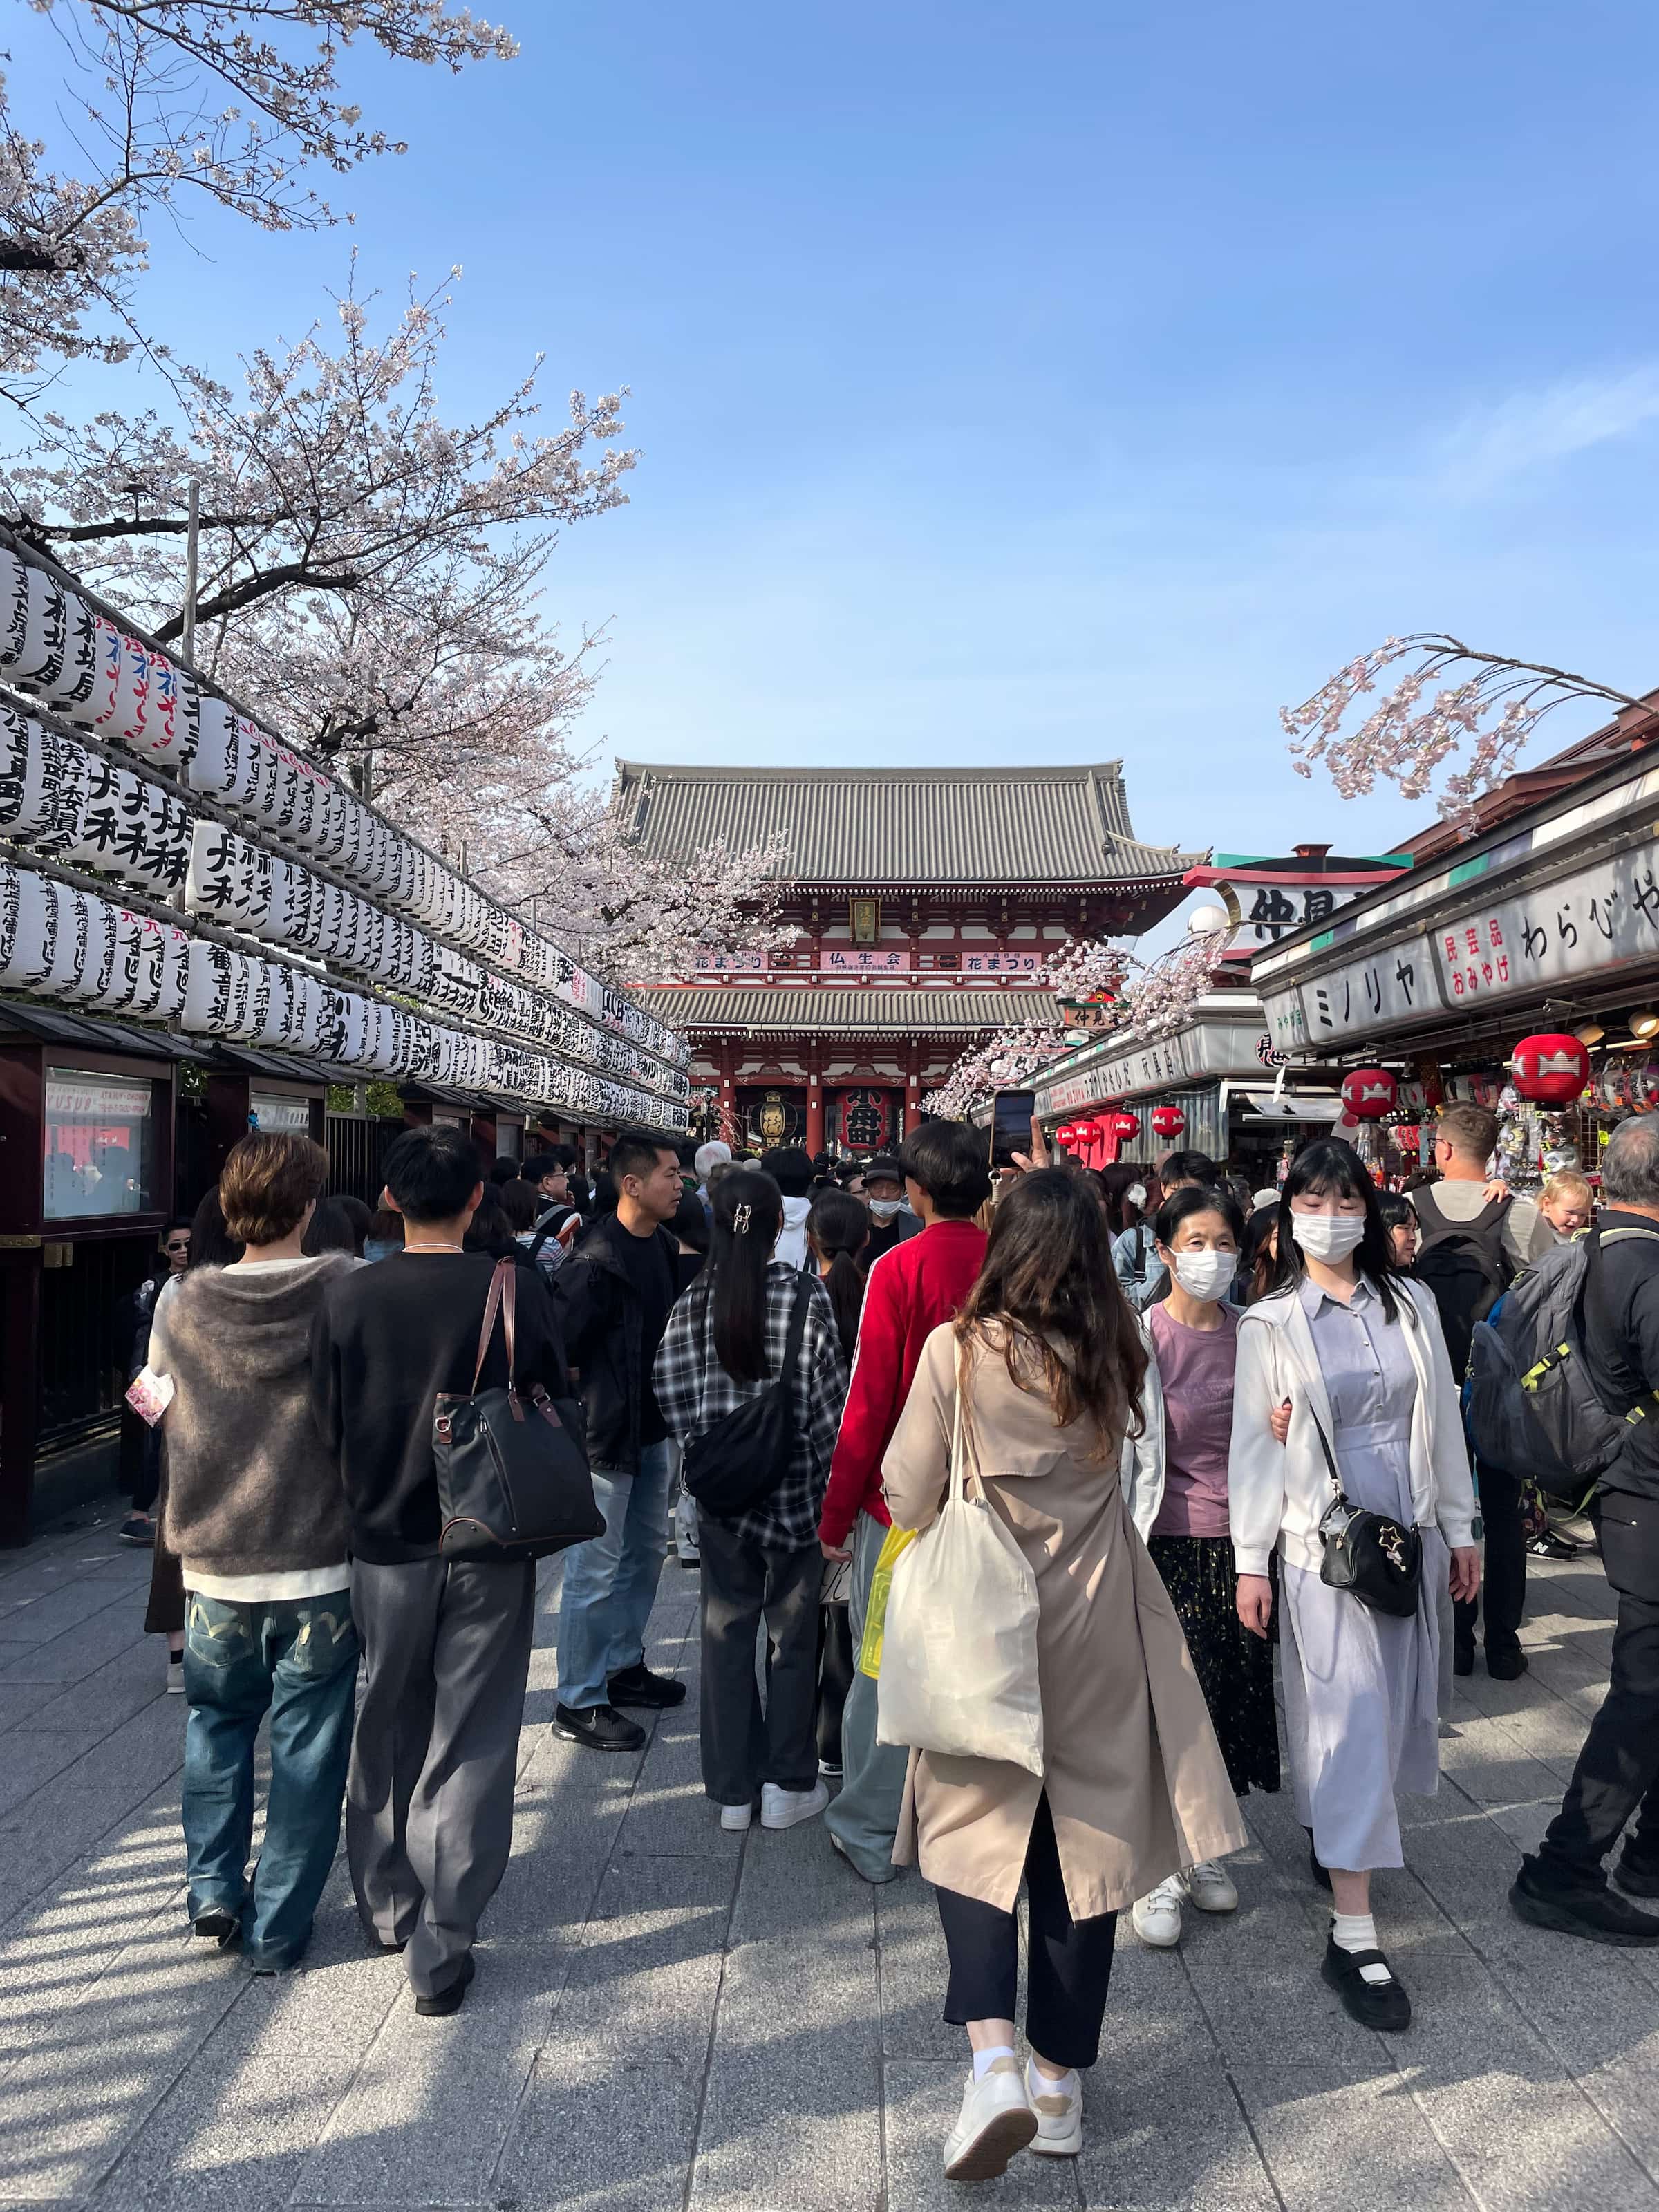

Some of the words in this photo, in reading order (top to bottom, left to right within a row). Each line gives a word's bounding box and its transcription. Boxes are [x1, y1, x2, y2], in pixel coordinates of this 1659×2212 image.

[1249, 889, 1365, 940] 仲見
[1520, 869, 1659, 962] わらびや
[830, 953, 901, 965] 仏生会
[1445, 919, 1503, 963] 民芸品
[968, 957, 1034, 970] 花まつり
[1452, 955, 1510, 995] おみやげ
[1316, 959, 1414, 1028] ミノリヤ
